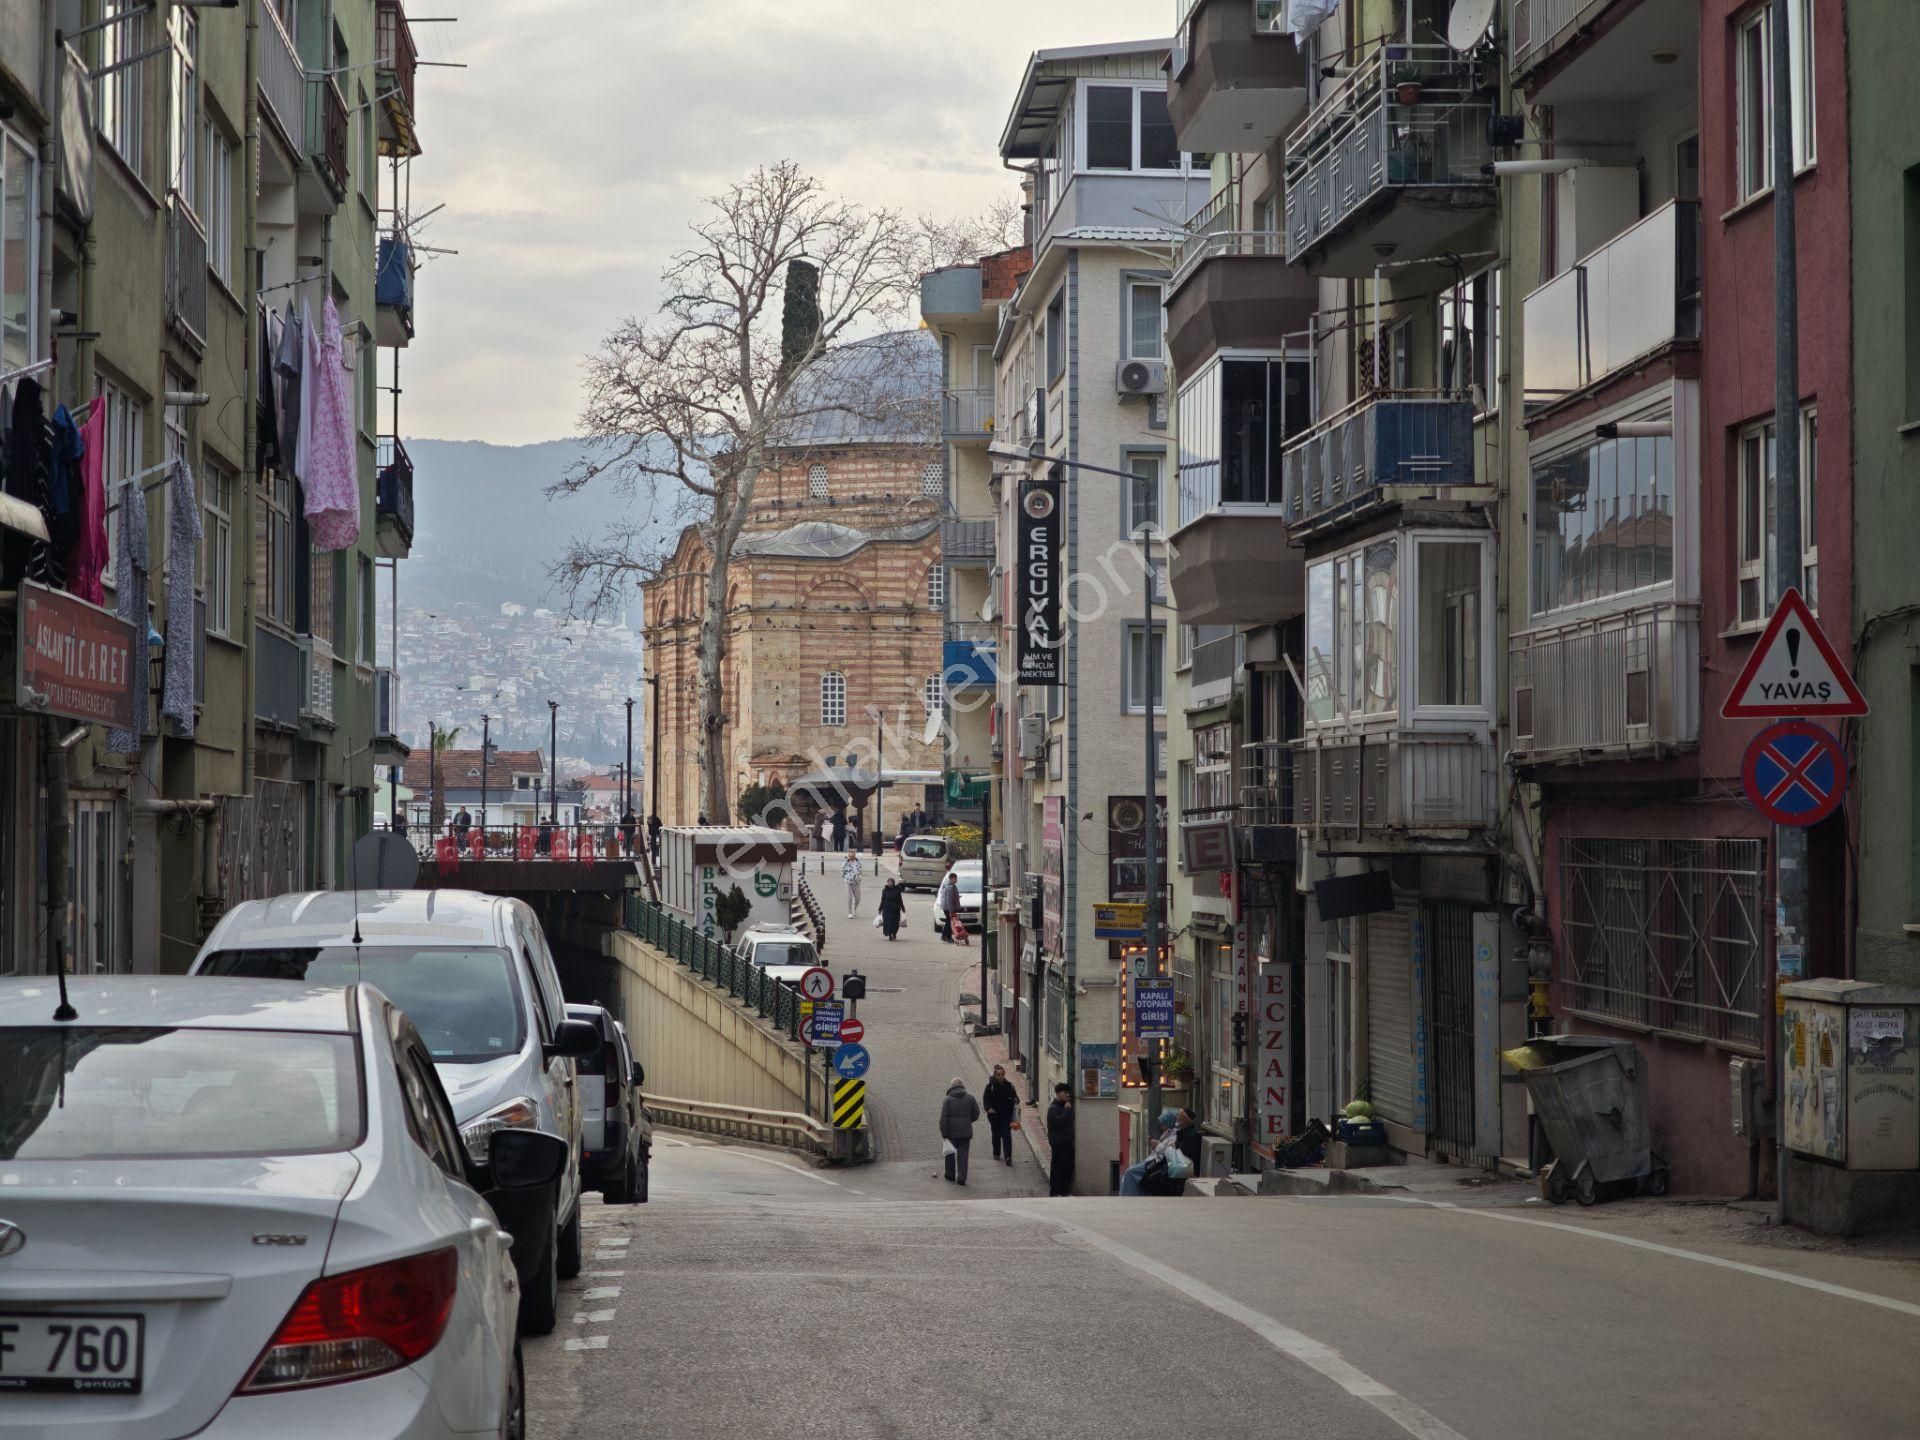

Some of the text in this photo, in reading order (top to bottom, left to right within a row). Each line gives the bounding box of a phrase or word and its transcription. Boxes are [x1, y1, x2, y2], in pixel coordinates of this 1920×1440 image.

[1029, 527, 1050, 649] ERGUVAN
[36, 623, 128, 686] ASLAN TİCARET
[1760, 682, 1831, 702] YAVAŞ
[1194, 831, 1223, 864] E
[1237, 931, 1247, 1011] CZANE
[1136, 1000, 1173, 1008] OTOPARK
[1141, 992, 1168, 1000] KAPALI
[1141, 1010, 1168, 1022] GİRİŞİ
[1878, 1021, 1899, 1029] BOYA
[815, 1022, 841, 1033] GİRİŞİ
[1265, 975, 1286, 1134] ECZANE
[47, 1325, 129, 1373] 760
[74, 1379, 132, 1390] Şentürk
